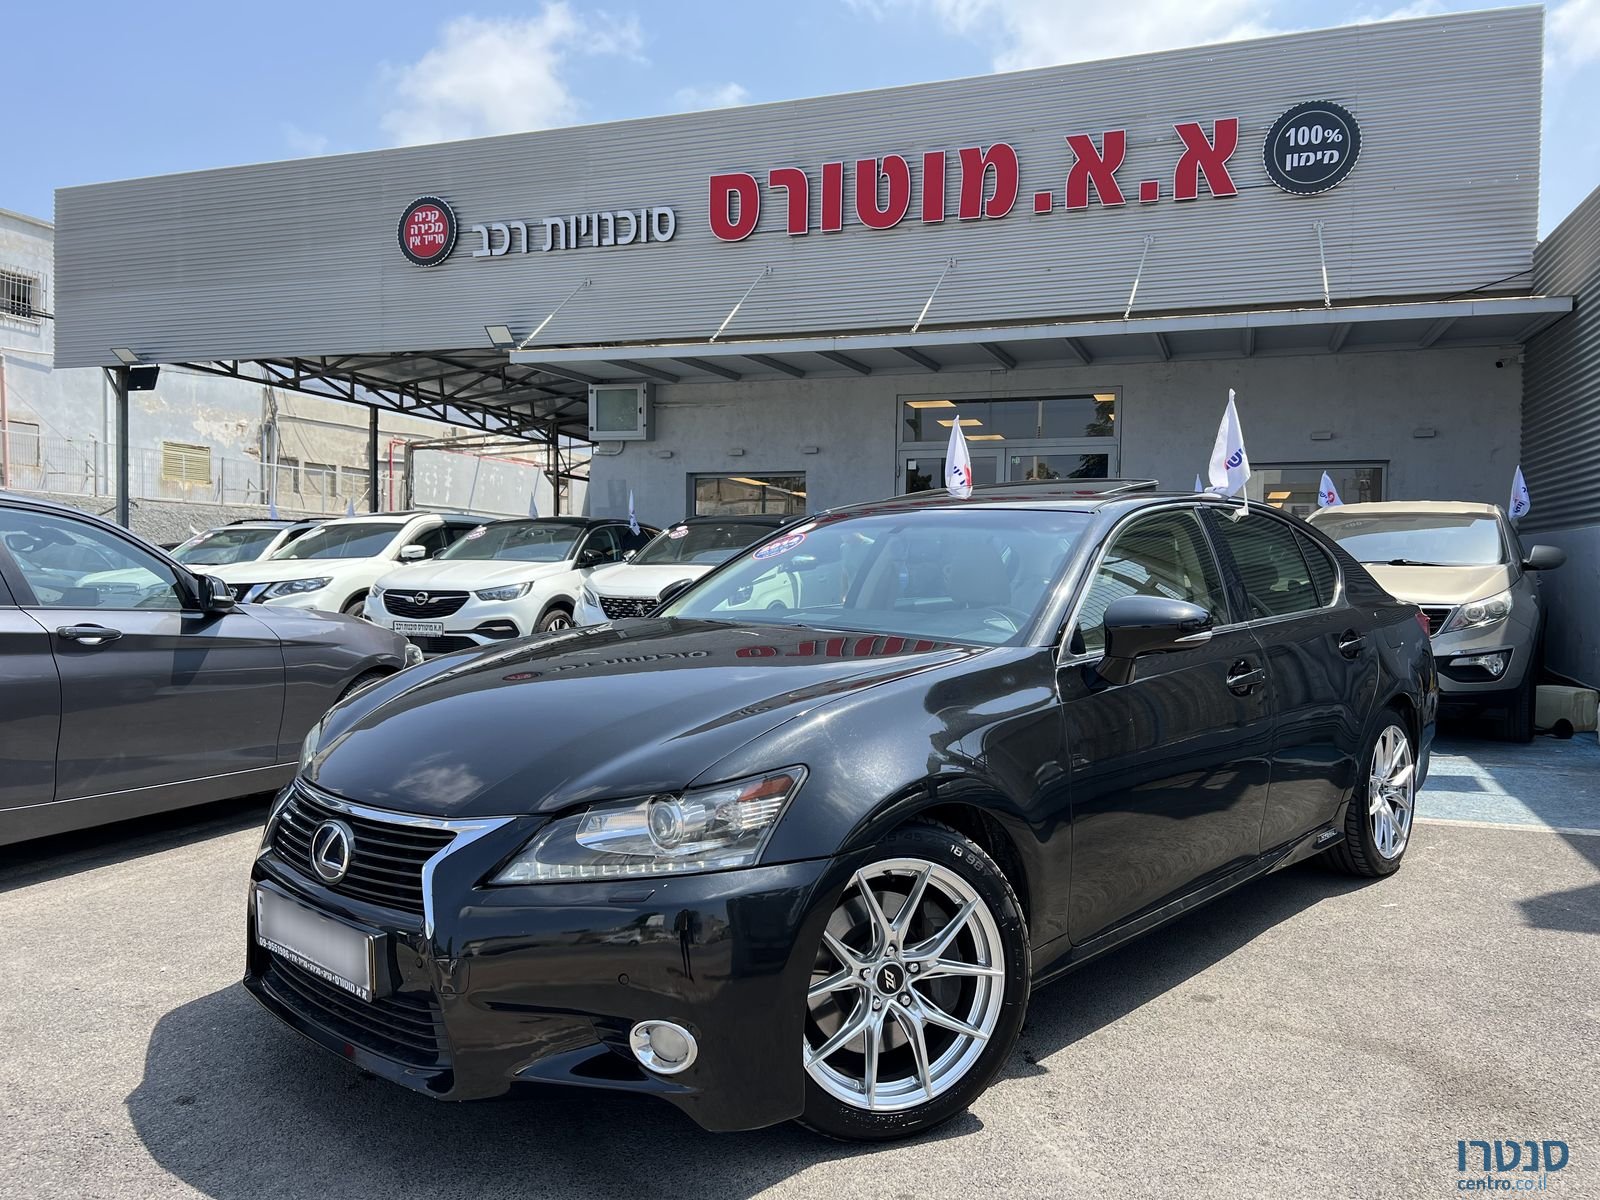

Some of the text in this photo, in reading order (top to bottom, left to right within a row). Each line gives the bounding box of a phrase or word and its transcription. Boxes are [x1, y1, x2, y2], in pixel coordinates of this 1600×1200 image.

[1285, 125, 1343, 147] 100%
[1285, 149, 1340, 171] מימון
[414, 210, 439, 223] קניה
[410, 222, 444, 235] מכירה
[472, 206, 677, 257] סוכנויות רכב
[409, 233, 445, 249] טרייד אין
[949, 844, 963, 857] 18
